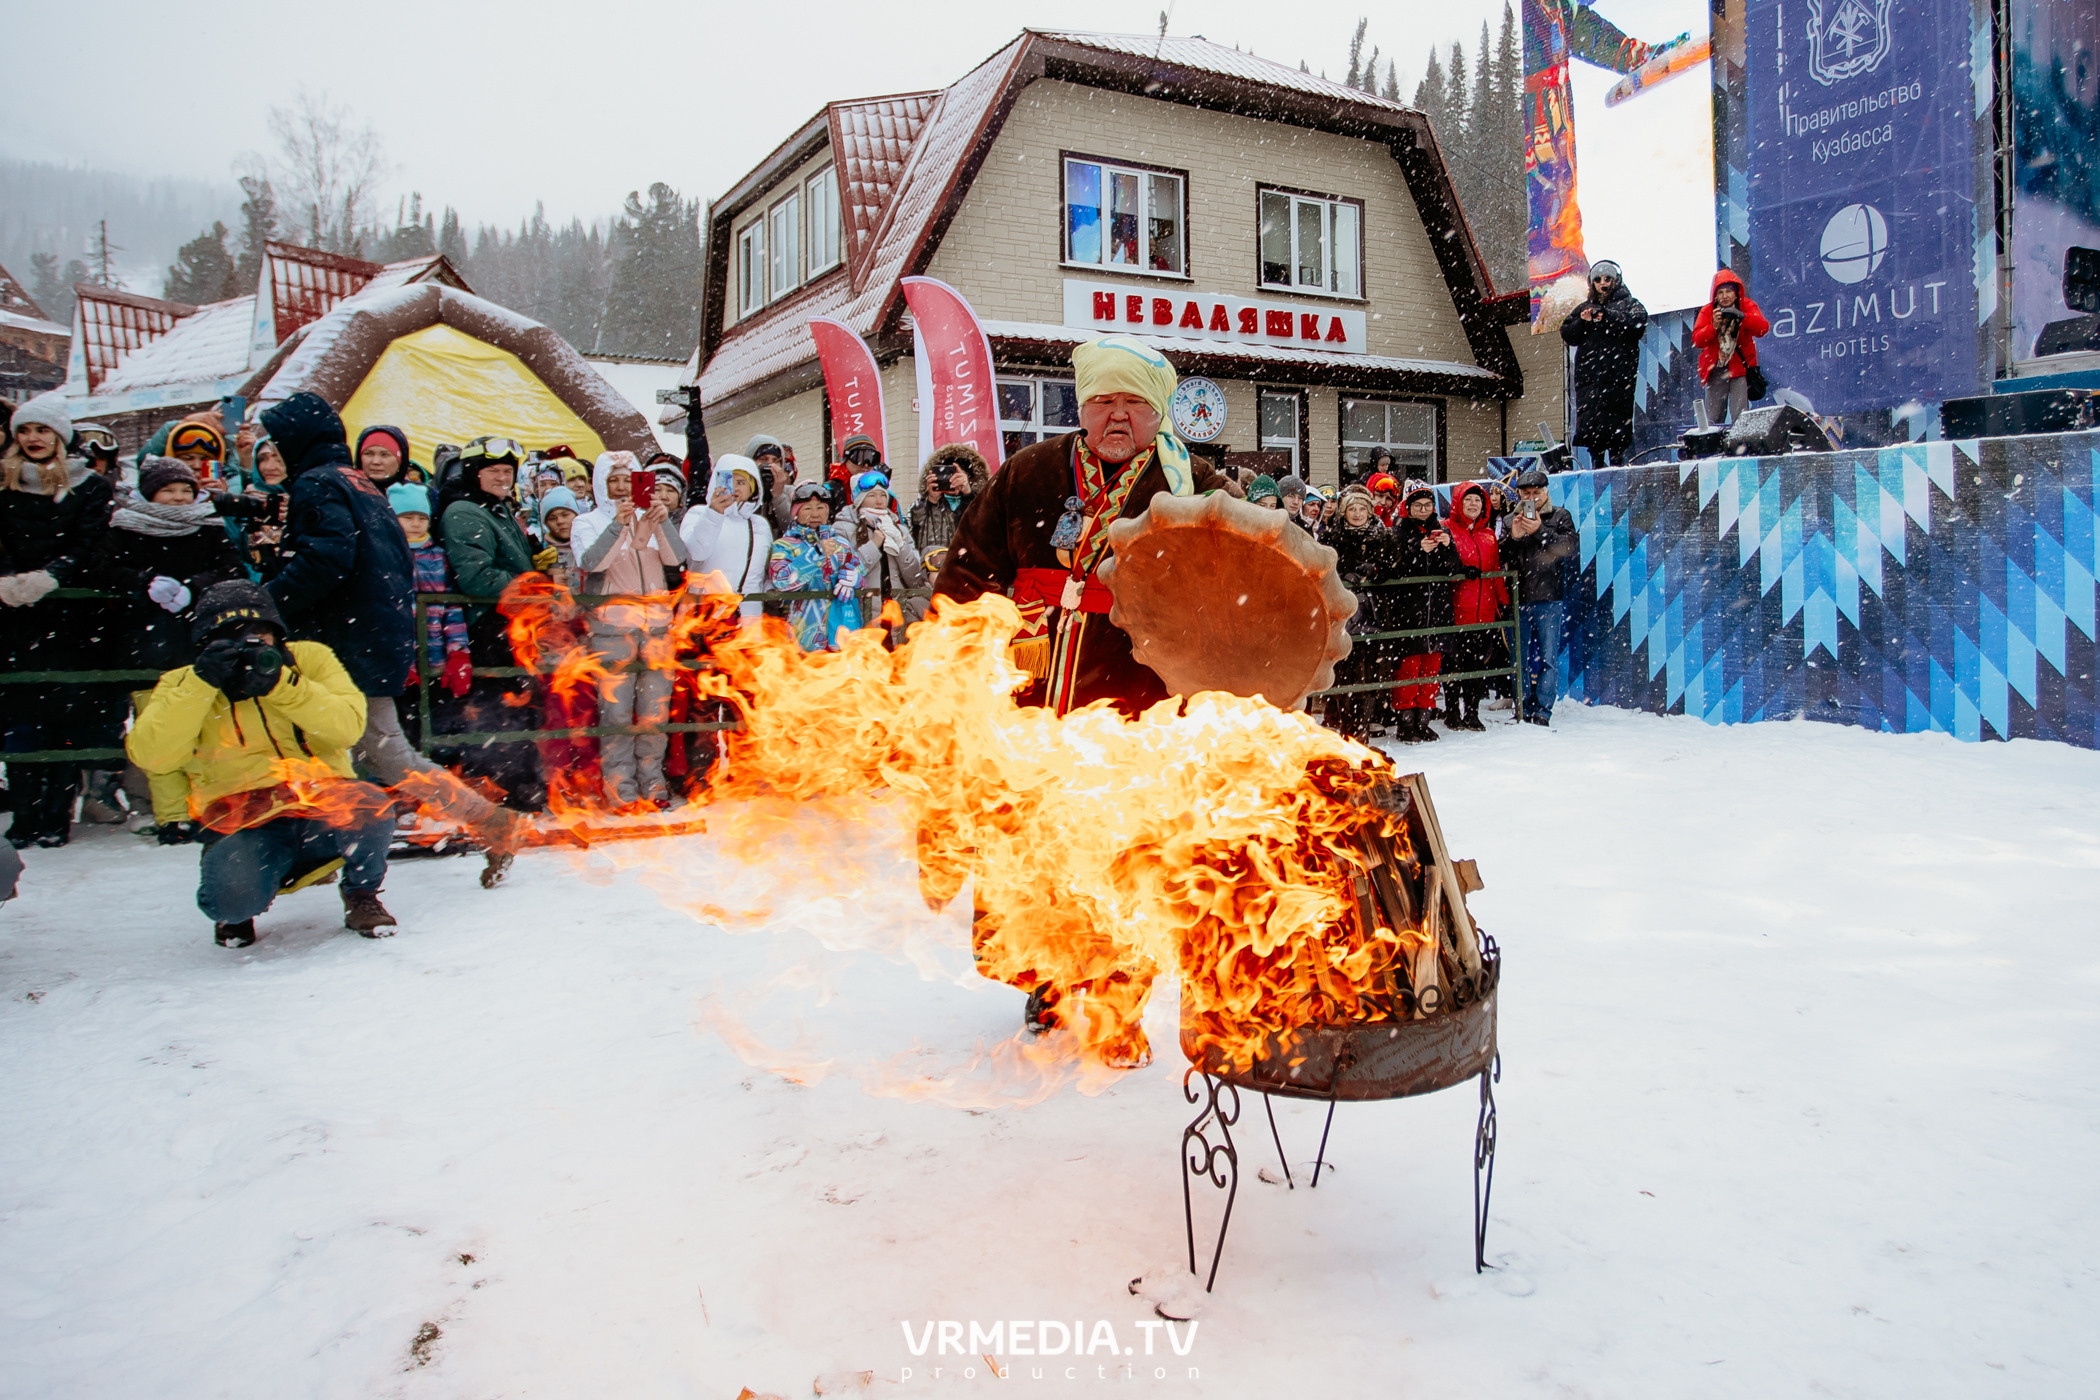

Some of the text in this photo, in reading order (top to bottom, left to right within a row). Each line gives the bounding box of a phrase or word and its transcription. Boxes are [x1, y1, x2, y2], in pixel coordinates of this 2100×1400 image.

[1786, 82, 1921, 138] Правительство
[1812, 124, 1892, 164] Кузбасса
[1093, 291, 1346, 342] НЕВАЛЯШКА
[1821, 334, 1890, 360] HOTELS
[1179, 421, 1221, 438] НЕВАЛЯШКА
